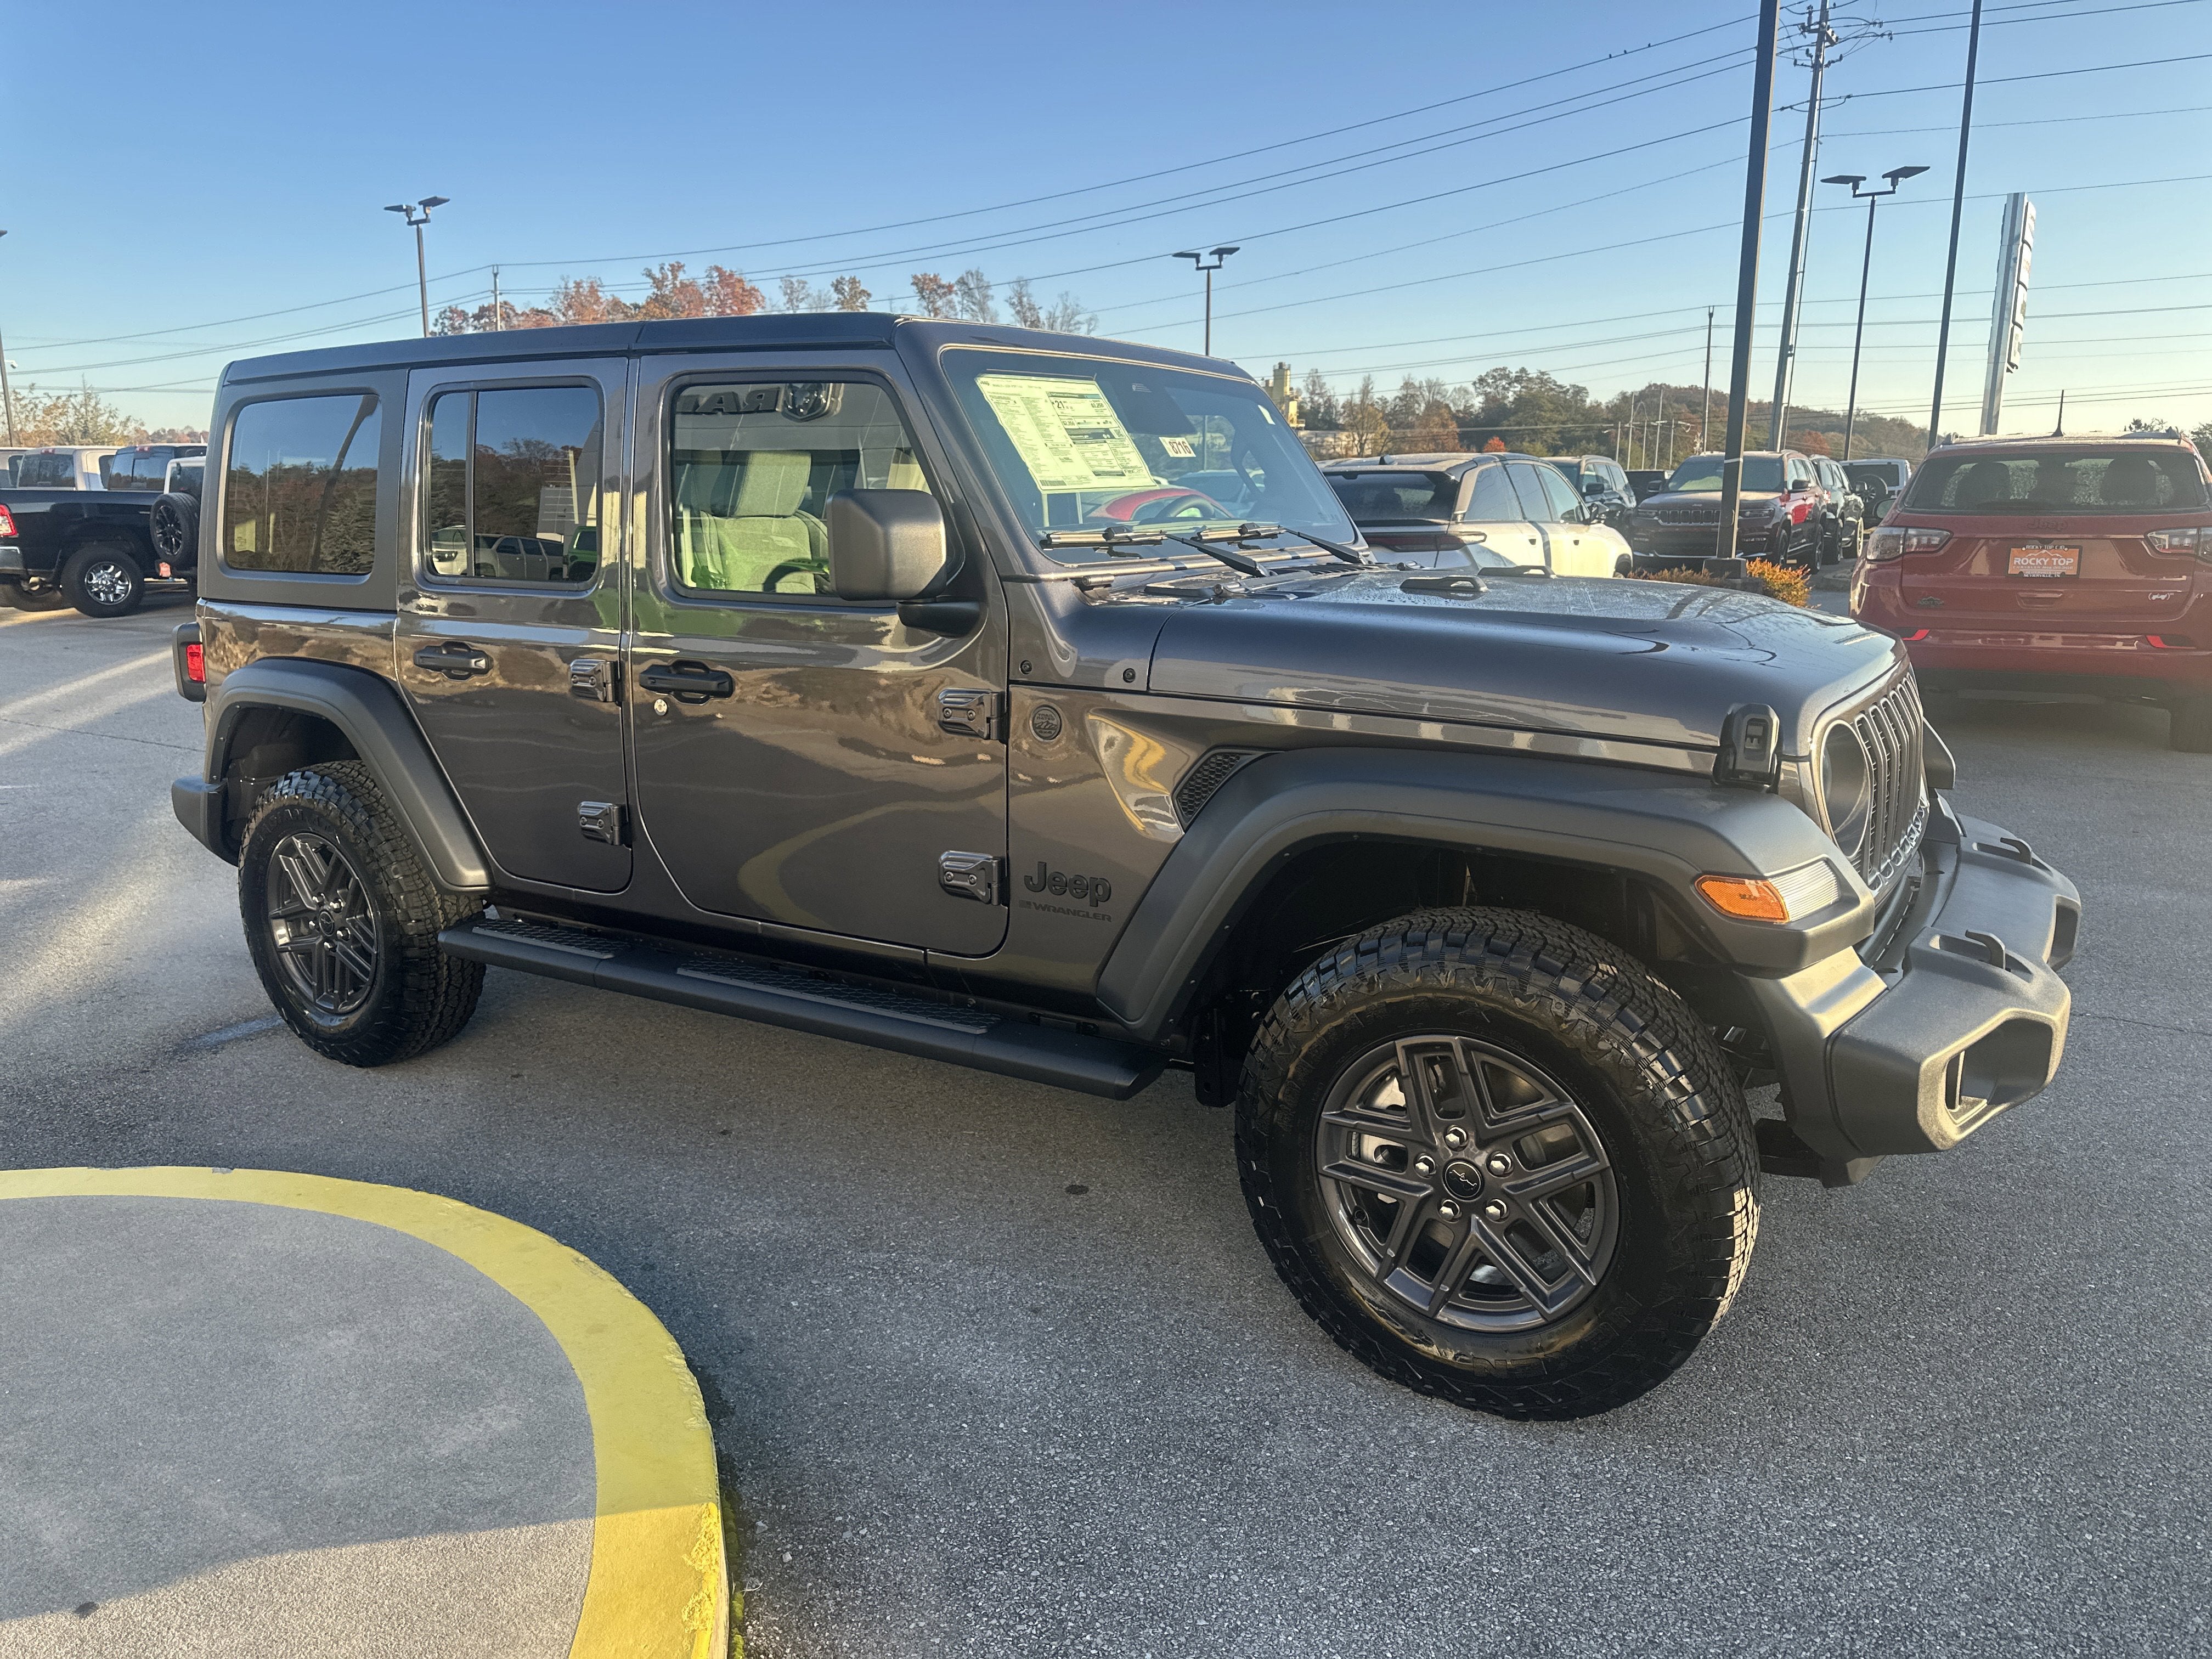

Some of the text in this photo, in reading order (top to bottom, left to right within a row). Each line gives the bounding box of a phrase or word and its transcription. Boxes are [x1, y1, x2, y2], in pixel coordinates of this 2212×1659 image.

[1054, 400, 1065, 409] 21
[1169, 441, 1192, 454] 8716
[2013, 557, 2050, 566] ROCKY
[1024, 861, 1111, 907] Jeep
[1032, 901, 1112, 922] WRANGLER
